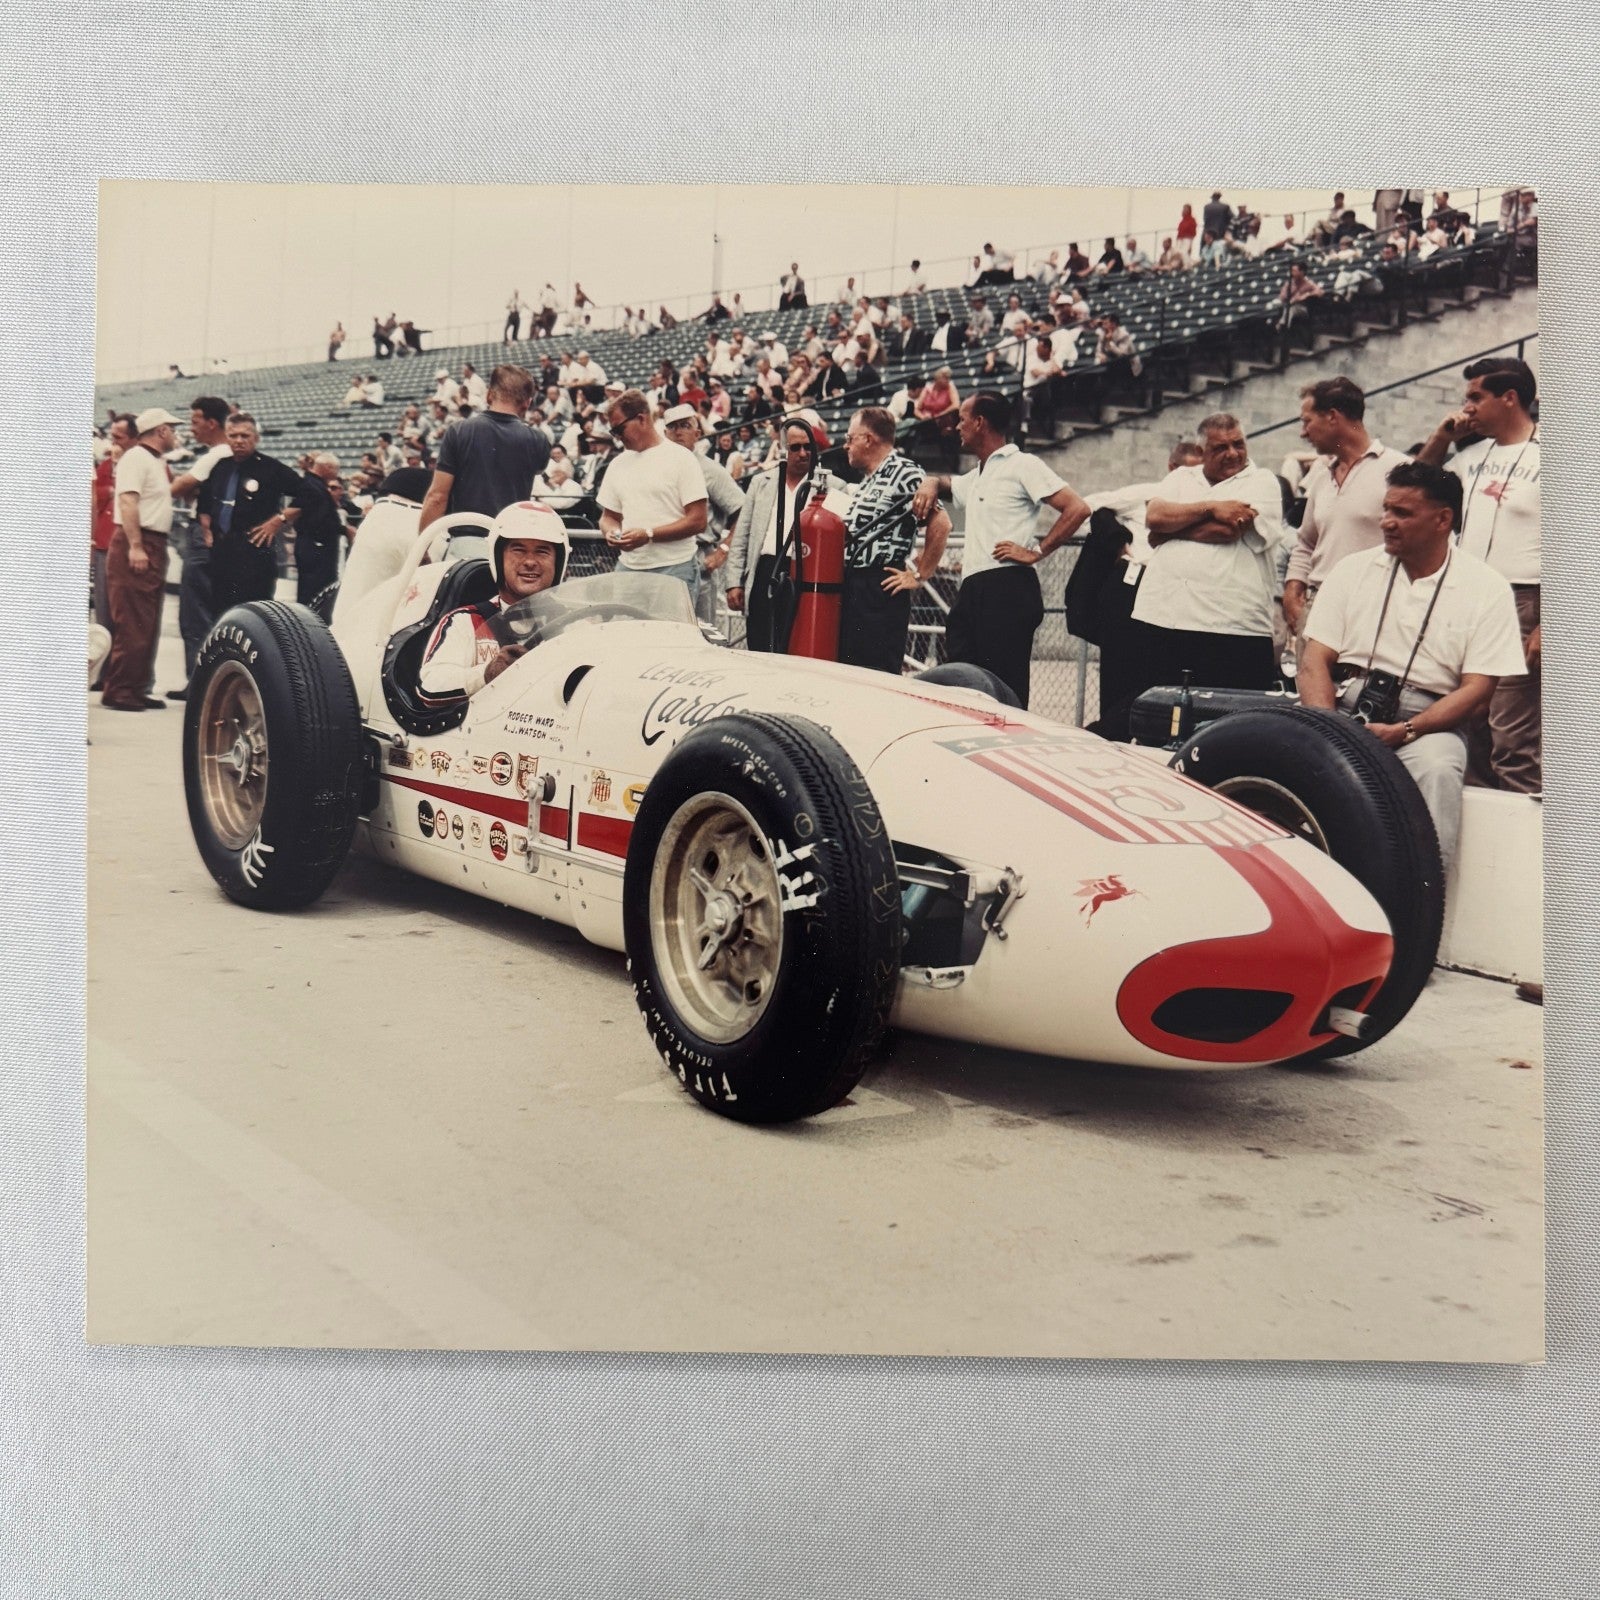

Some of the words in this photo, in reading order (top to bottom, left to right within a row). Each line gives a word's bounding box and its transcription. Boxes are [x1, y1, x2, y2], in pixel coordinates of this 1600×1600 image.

[638, 662, 726, 688] LEADER
[508, 710, 533, 724] RODGER
[535, 716, 555, 728] WARD
